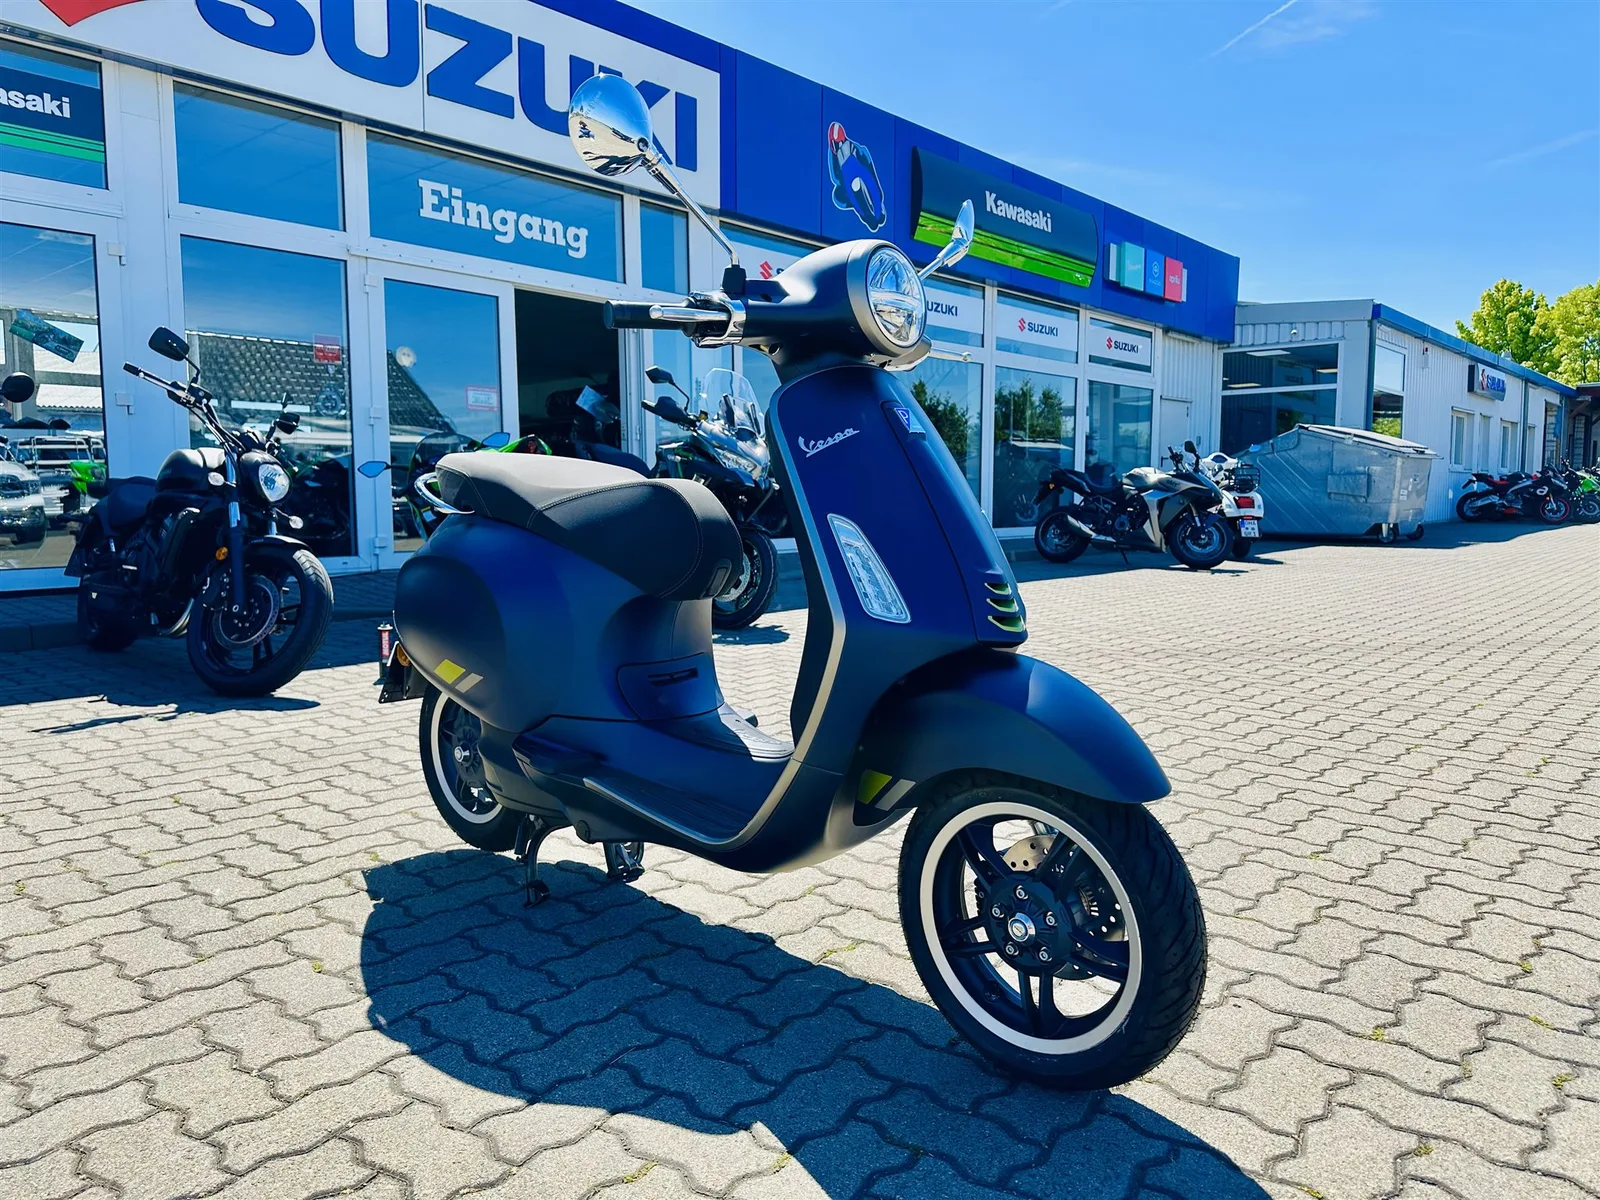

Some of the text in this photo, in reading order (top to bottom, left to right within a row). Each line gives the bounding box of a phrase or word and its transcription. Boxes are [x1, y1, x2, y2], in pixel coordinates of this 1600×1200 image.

[418, 178, 588, 259] Eingang
[985, 190, 1052, 233] Kawasaki
[1027, 321, 1059, 337] SUZUKI
[1113, 340, 1139, 354] SUZUKI
[798, 428, 860, 458] Vespa
[382, 632, 390, 656] MOTUL
